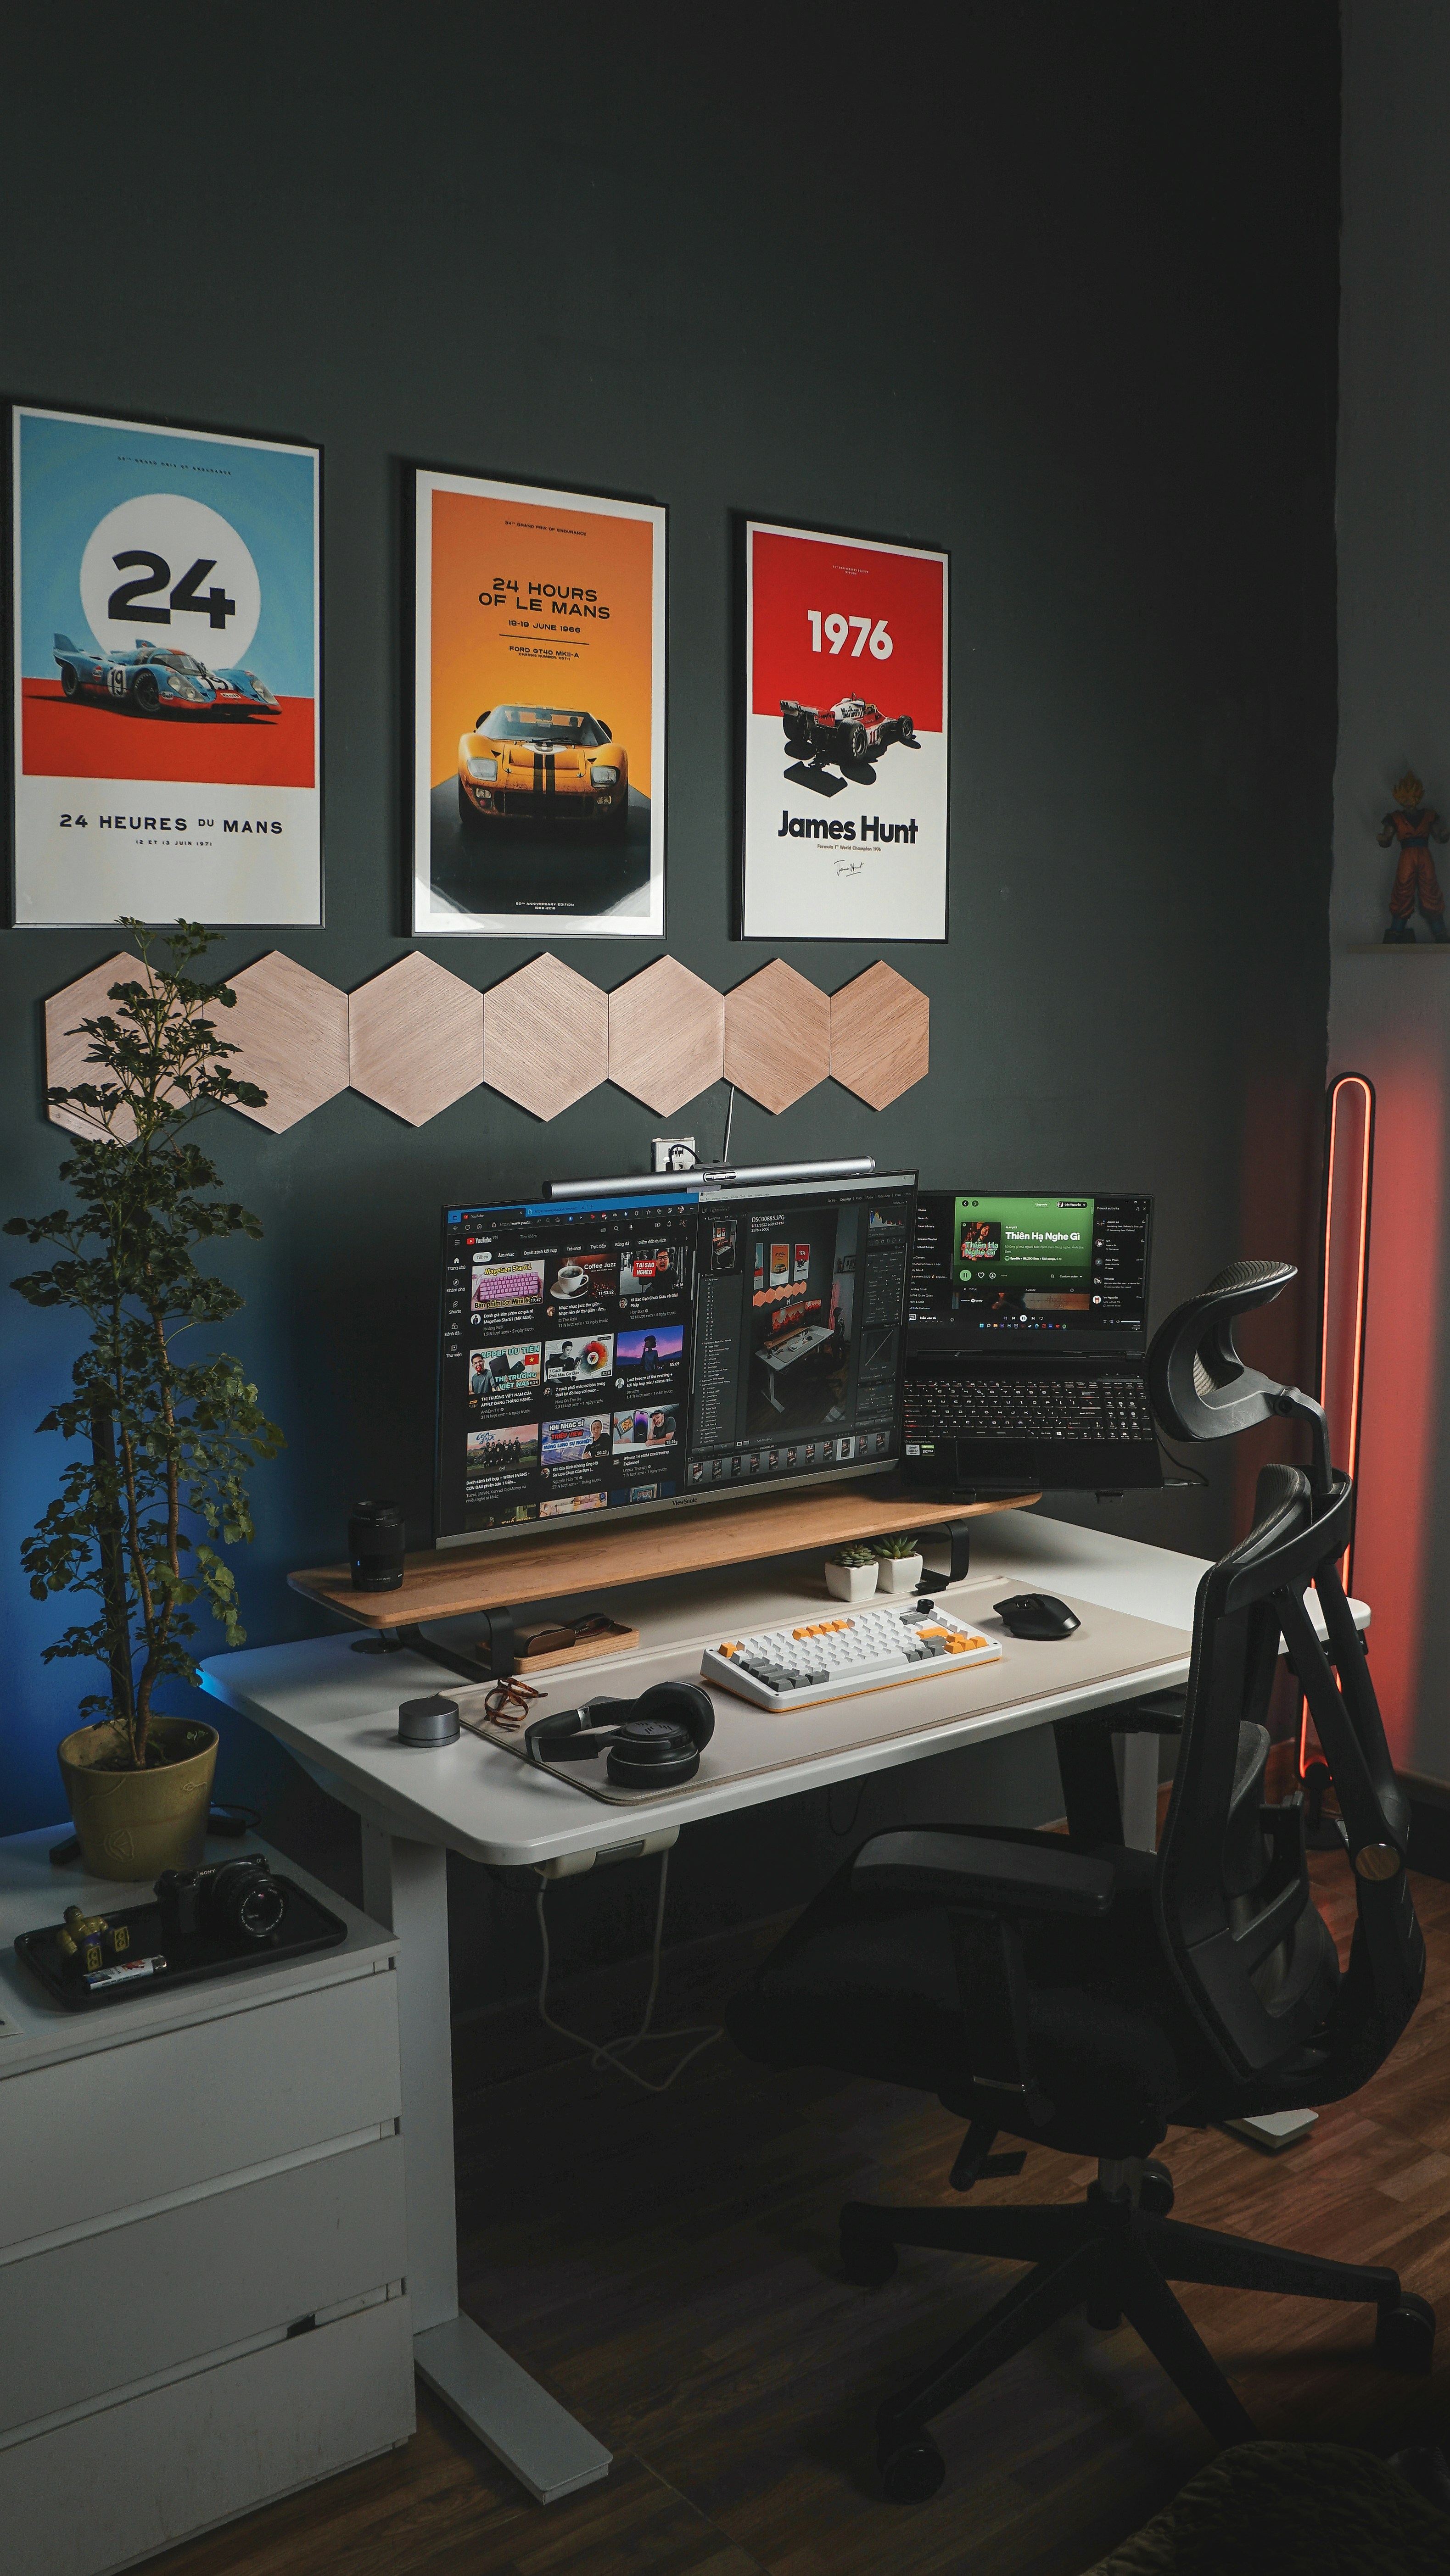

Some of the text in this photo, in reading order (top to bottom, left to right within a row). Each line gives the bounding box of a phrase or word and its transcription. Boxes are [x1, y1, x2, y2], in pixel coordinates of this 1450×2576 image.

[557, 528, 587, 536] ENDURANCE
[108, 550, 235, 630] 24
[493, 577, 597, 602] 24 HOURS
[479, 592, 610, 619] OF LE MANS
[509, 619, 530, 628] 18-19
[533, 622, 557, 631] JUNE
[807, 609, 893, 661] 1976
[110, 669, 124, 696] 19
[60, 814, 283, 835] 24 HEURES DU MANS
[778, 810, 918, 844] James Hunt
[1005, 1231, 1030, 1240] Thiên
[1031, 1232, 1044, 1242] Hạ
[1045, 1232, 1069, 1242] Nghe
[485, 1266, 511, 1276] MageGee
[487, 1300, 501, 1309] phím
[508, 1347, 520, 1356] ƯU
[521, 1344, 540, 1354] TIÊN
[560, 1421, 577, 1430] NHẠC
[551, 1429, 584, 1441] TRIỆU VIEW
[672, 1497, 697, 1506] ViewSonic
